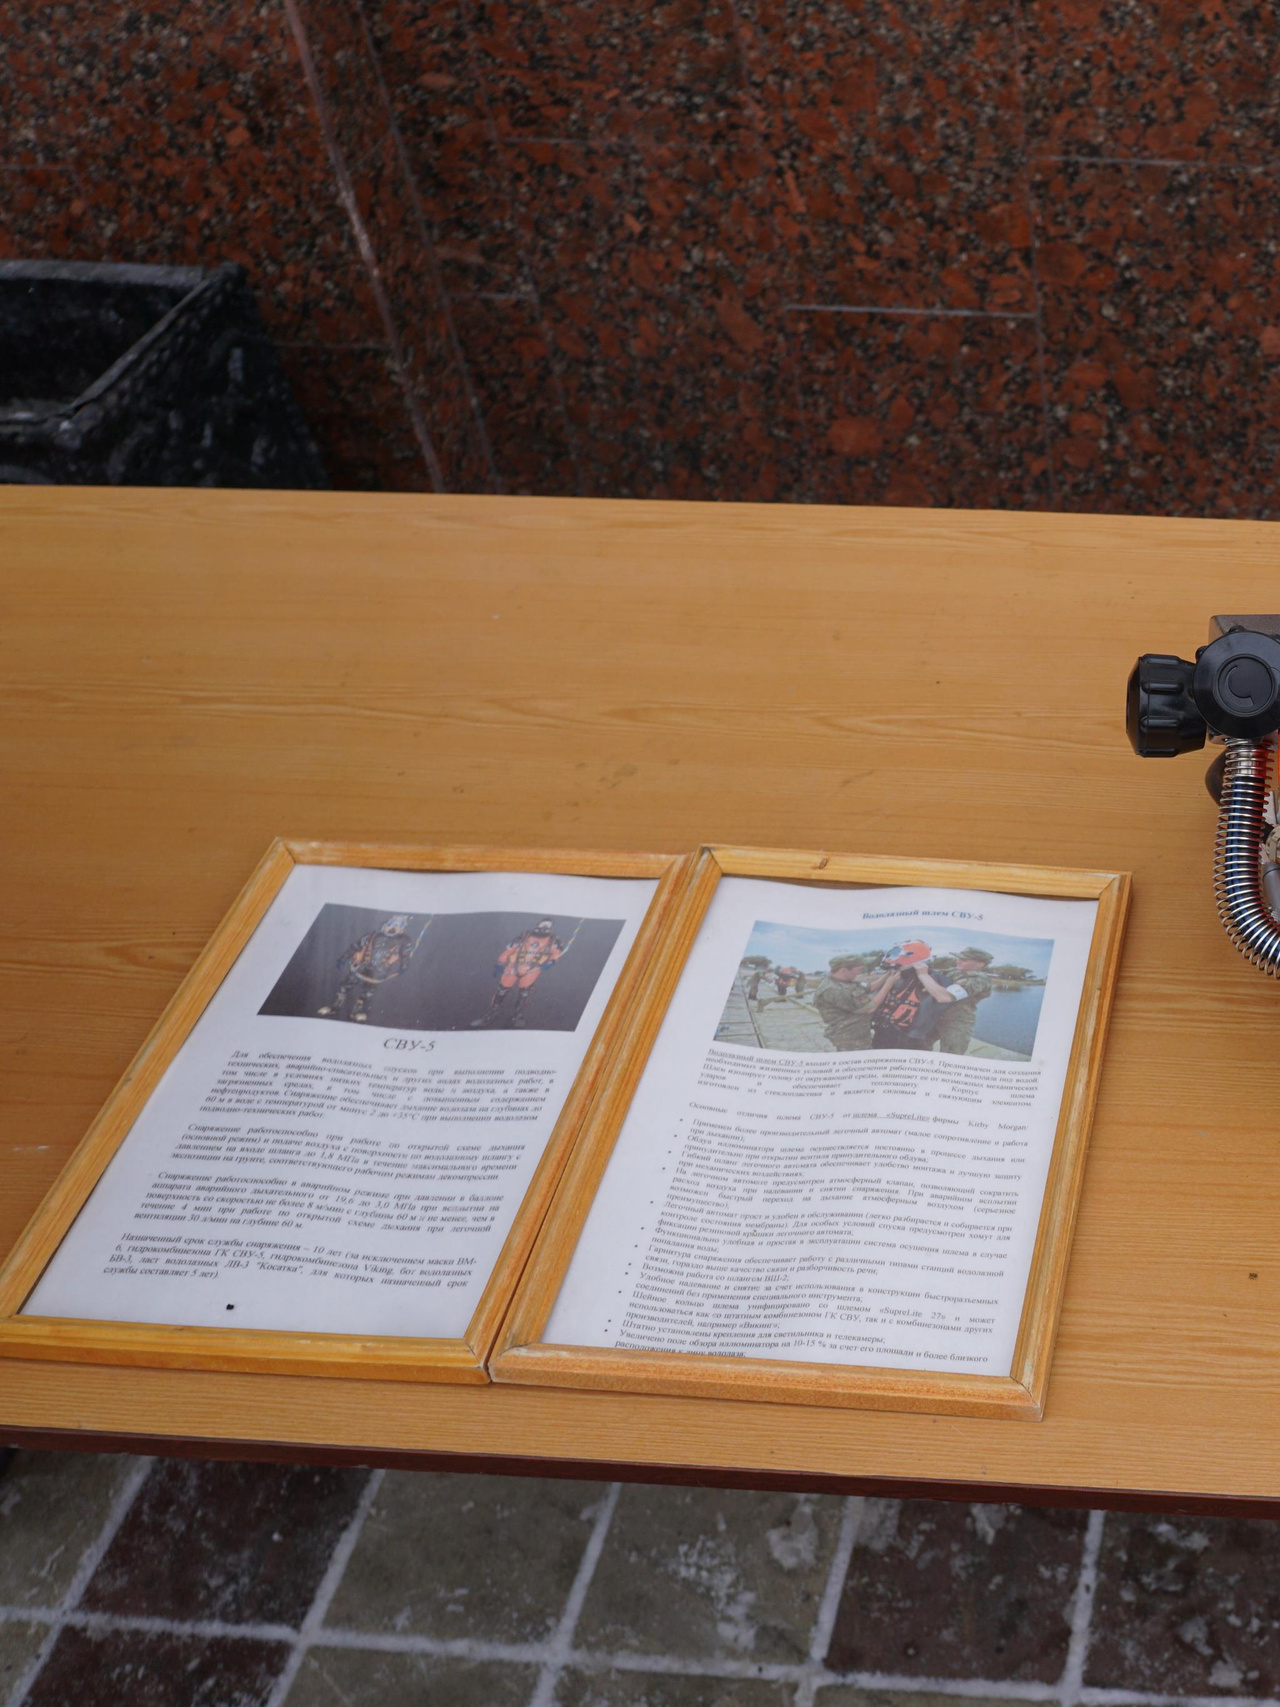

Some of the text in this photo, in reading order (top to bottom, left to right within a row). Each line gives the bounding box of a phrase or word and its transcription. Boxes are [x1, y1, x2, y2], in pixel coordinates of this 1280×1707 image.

[862, 909, 984, 921] Водолазный шлем СВУ-5
[383, 1037, 436, 1052] СВУ-5
[689, 1103, 726, 1113] Основные
[887, 1113, 930, 1121] «SupreLite»
[932, 1116, 959, 1124] фирмы
[172, 1153, 221, 1161] экспозиции
[354, 1168, 394, 1177] рабочим
[158, 1172, 212, 1181] Снаряжение
[300, 1182, 351, 1193] аварийном
[353, 1190, 390, 1199] режиме
[469, 1194, 504, 1202] баллоне
[134, 1213, 186, 1221] вентиляции
[242, 1218, 279, 1226] глубине
[665, 1202, 704, 1213] Легочный
[893, 1216, 941, 1226] разбирается
[951, 1222, 995, 1231] собирается
[121, 1233, 182, 1243] Назначенный
[184, 1238, 205, 1246] срок
[207, 1239, 243, 1247] службы
[246, 1242, 301, 1251] снаряжения
[313, 1246, 325, 1254] 10
[362, 1255, 425, 1264] исключением
[457, 1257, 477, 1265] ВМ-
[649, 1245, 691, 1258] Гарнитура
[694, 1255, 742, 1263] снаряжения
[799, 1255, 824, 1264] работу
[835, 1257, 885, 1265] различными
[889, 1261, 918, 1269] типами
[957, 1269, 1004, 1277] водолазной
[672, 1260, 704, 1269] гораздо
[796, 1264, 854, 1272] разборчивость
[103, 1266, 138, 1275] службы
[165, 1258, 219, 1267] водолазных
[224, 1260, 250, 1268] ЛВ-3
[334, 1273, 374, 1283] которых
[381, 1279, 441, 1287] назначенный
[447, 1281, 468, 1289] срок
[399, 1267, 415, 1275] бот
[642, 1263, 684, 1276] Возможна
[686, 1272, 713, 1280] работа
[636, 1283, 685, 1295] соединений
[686, 1289, 700, 1297] без
[632, 1291, 667, 1303] Шейное
[748, 1303, 810, 1311] унифицировано
[880, 1307, 922, 1317] «SupreLite
[622, 1320, 656, 1331] Штатно
[657, 1327, 711, 1337] установлены
[763, 1311, 822, 1319] комбинезоном
[896, 1319, 961, 1331] комбинезонами
